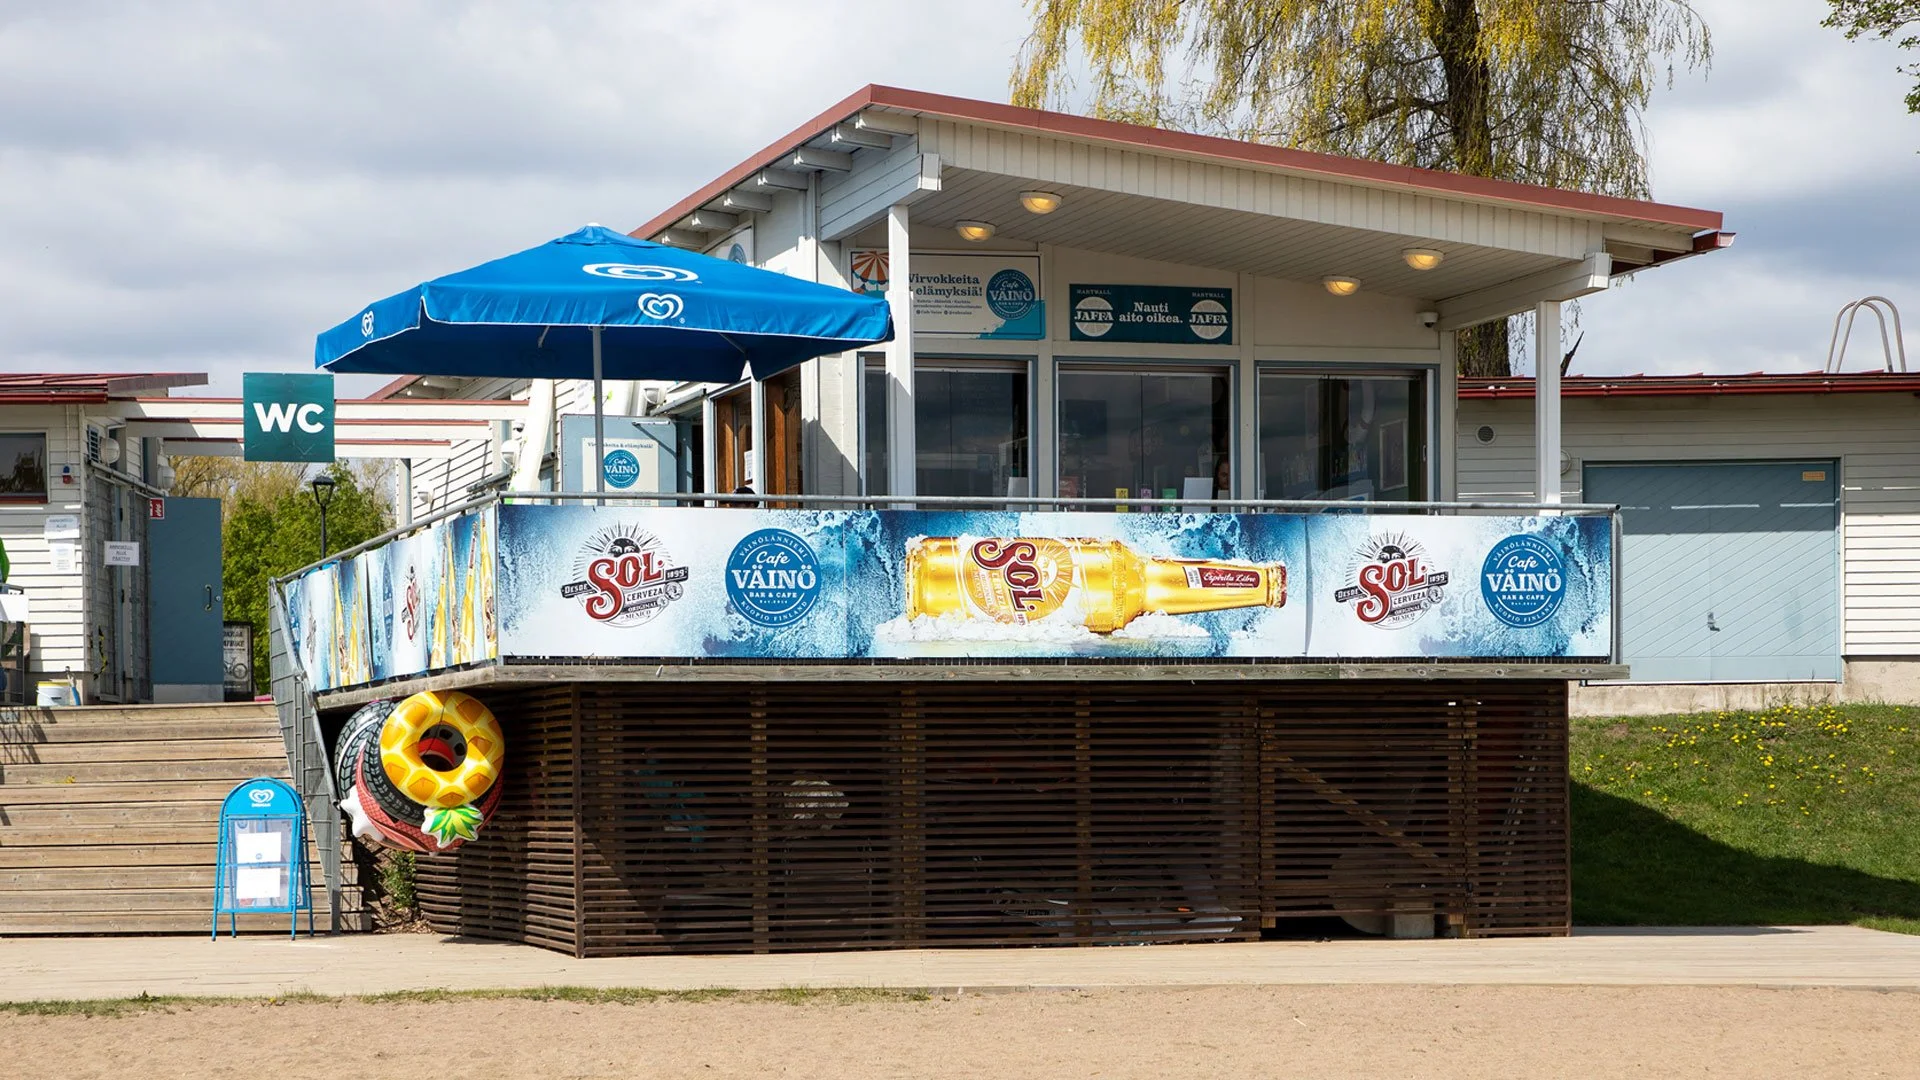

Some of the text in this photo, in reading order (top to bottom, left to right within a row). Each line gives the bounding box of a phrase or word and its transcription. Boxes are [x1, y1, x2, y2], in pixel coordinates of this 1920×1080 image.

[908, 273, 980, 285] Virvokkeita
[915, 285, 983, 299] elämyksiä!
[989, 287, 1033, 301] VÄINÖ
[1133, 302, 1169, 313] Nauti
[1074, 310, 1114, 321] JAFFA
[1119, 312, 1183, 324] aito oikea.
[1188, 313, 1228, 324] JAFFA
[252, 402, 325, 434] WC
[604, 464, 638, 475] VÄINÖ
[756, 551, 790, 568] Cafe
[1508, 555, 1539, 572] Cafe
[731, 564, 817, 590] VÄINÖ
[1485, 568, 1562, 592] VÄINÖ
[626, 587, 663, 602] CERVEZA
[1393, 591, 1426, 605] CERVEZA
[773, 601, 807, 621] FINLAND
